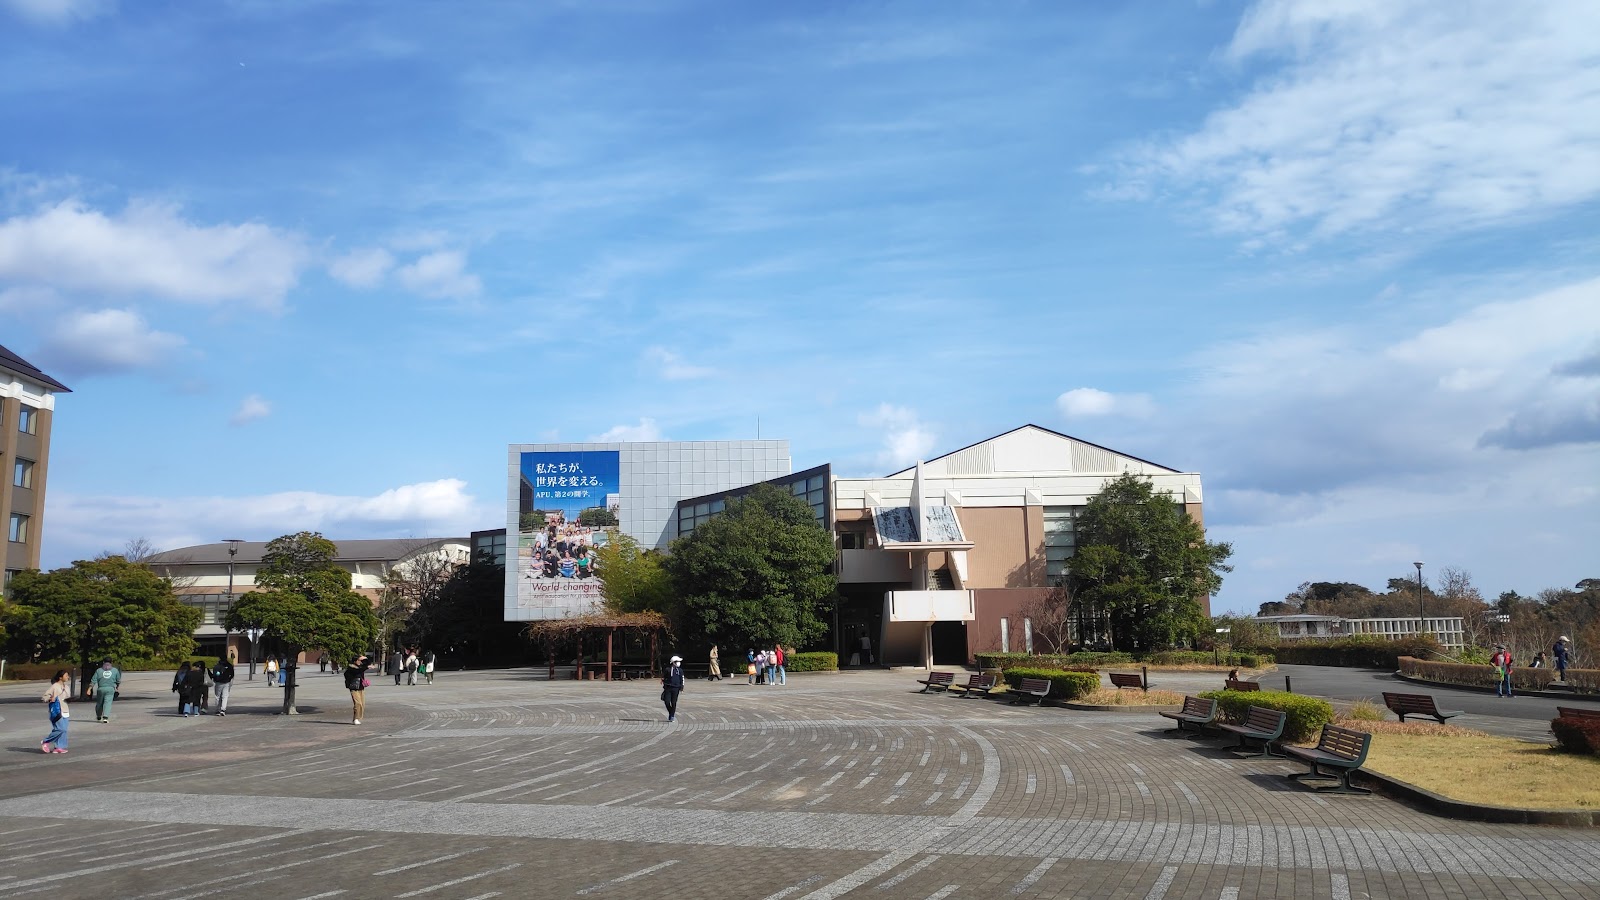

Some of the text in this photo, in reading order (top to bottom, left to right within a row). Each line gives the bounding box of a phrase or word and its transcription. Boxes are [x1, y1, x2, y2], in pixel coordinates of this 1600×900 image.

[536, 462, 584, 474] 私たちが、
[536, 476, 604, 487] 世界を変える。
